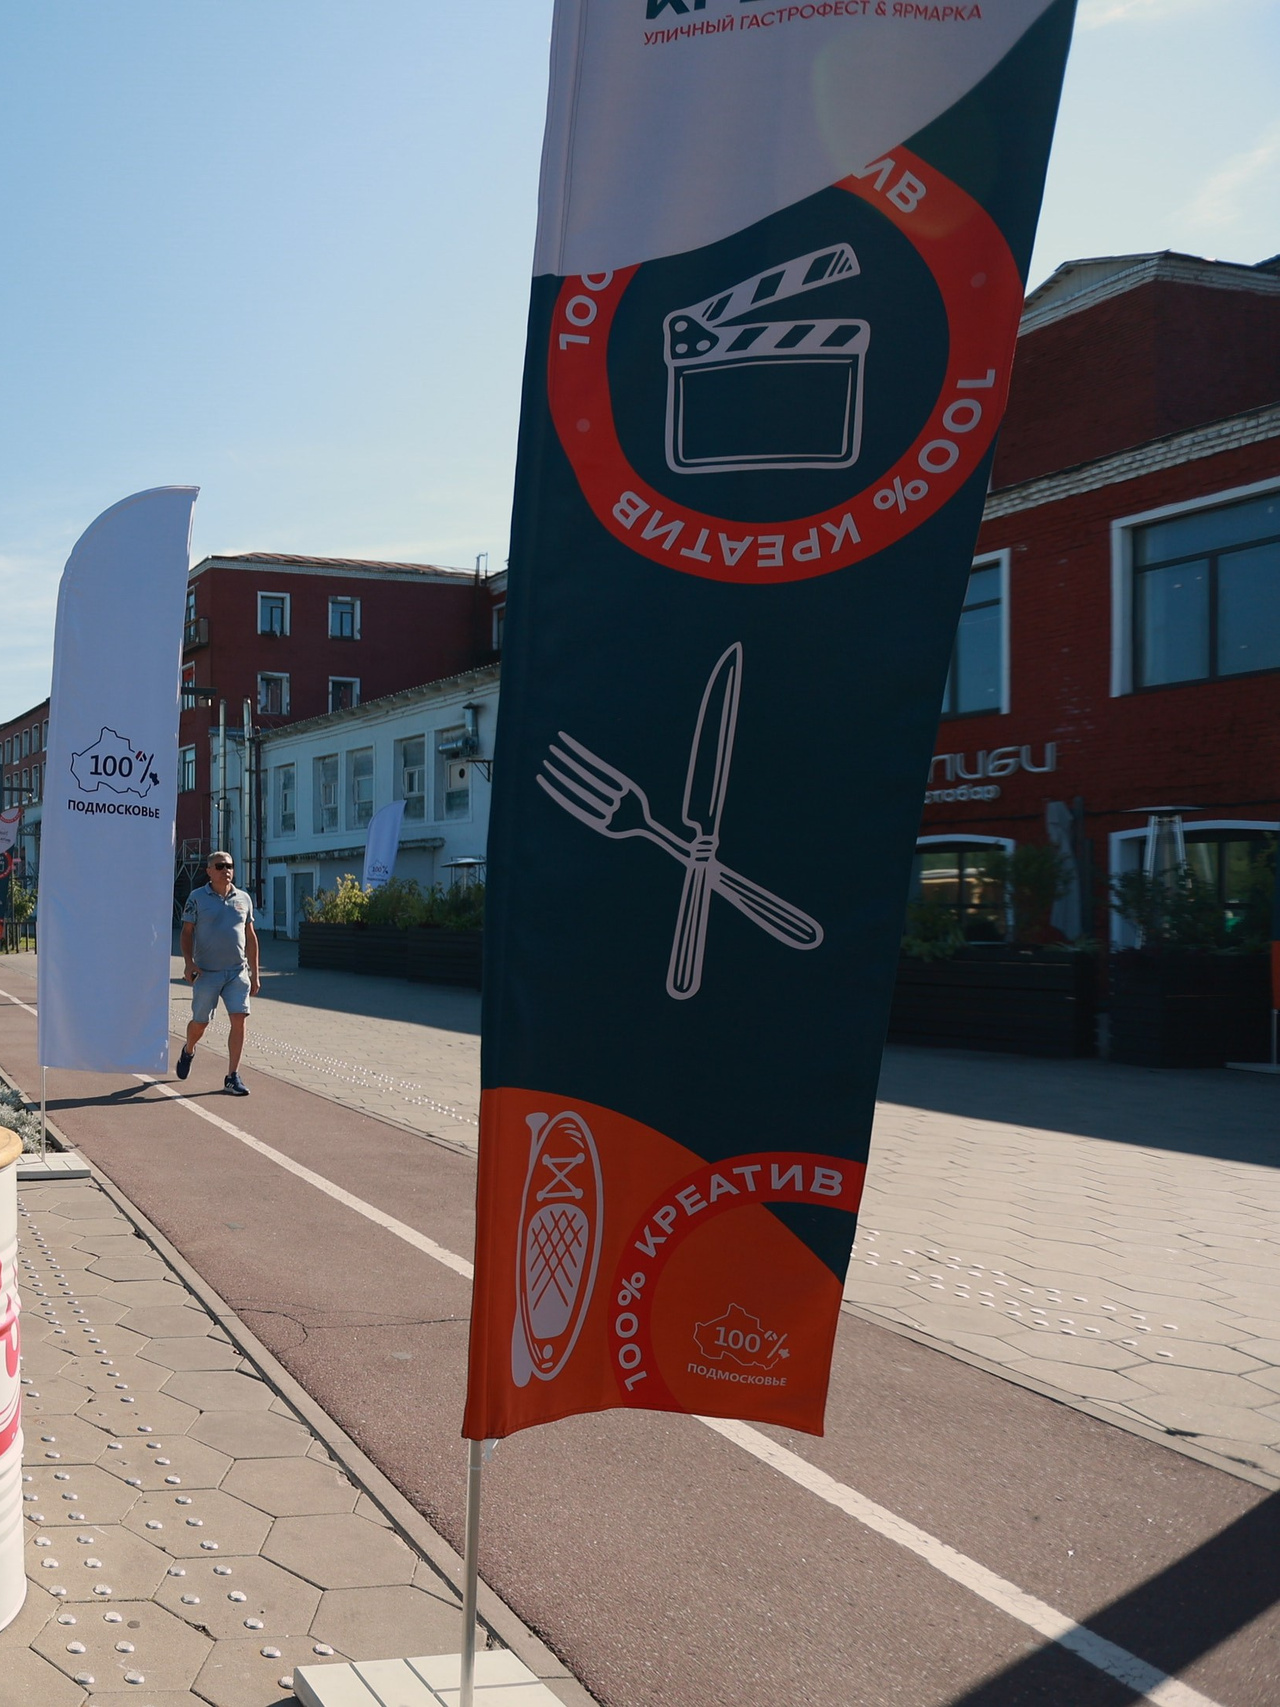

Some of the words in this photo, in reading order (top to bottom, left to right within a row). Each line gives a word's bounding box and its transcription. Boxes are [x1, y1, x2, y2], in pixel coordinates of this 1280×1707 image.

[644, 14, 735, 46] УЛИЧНЫЙ
[740, 0, 869, 30] ГАСТРОФЕСТ
[875, 1, 886, 16] &
[892, 2, 982, 21] ЯРМАРКА
[873, 368, 996, 514] 100%
[612, 490, 862, 568] КРЕАТИВ
[89, 751, 160, 786] 100%
[67, 799, 160, 819] ПОДМОСКОВЬЕ
[615, 1271, 648, 1392] 100%
[634, 1163, 843, 1259] КРЕАТИВ
[714, 1326, 790, 1359] 100%
[687, 1362, 788, 1387] ПОДМОСКОВЬЕ
